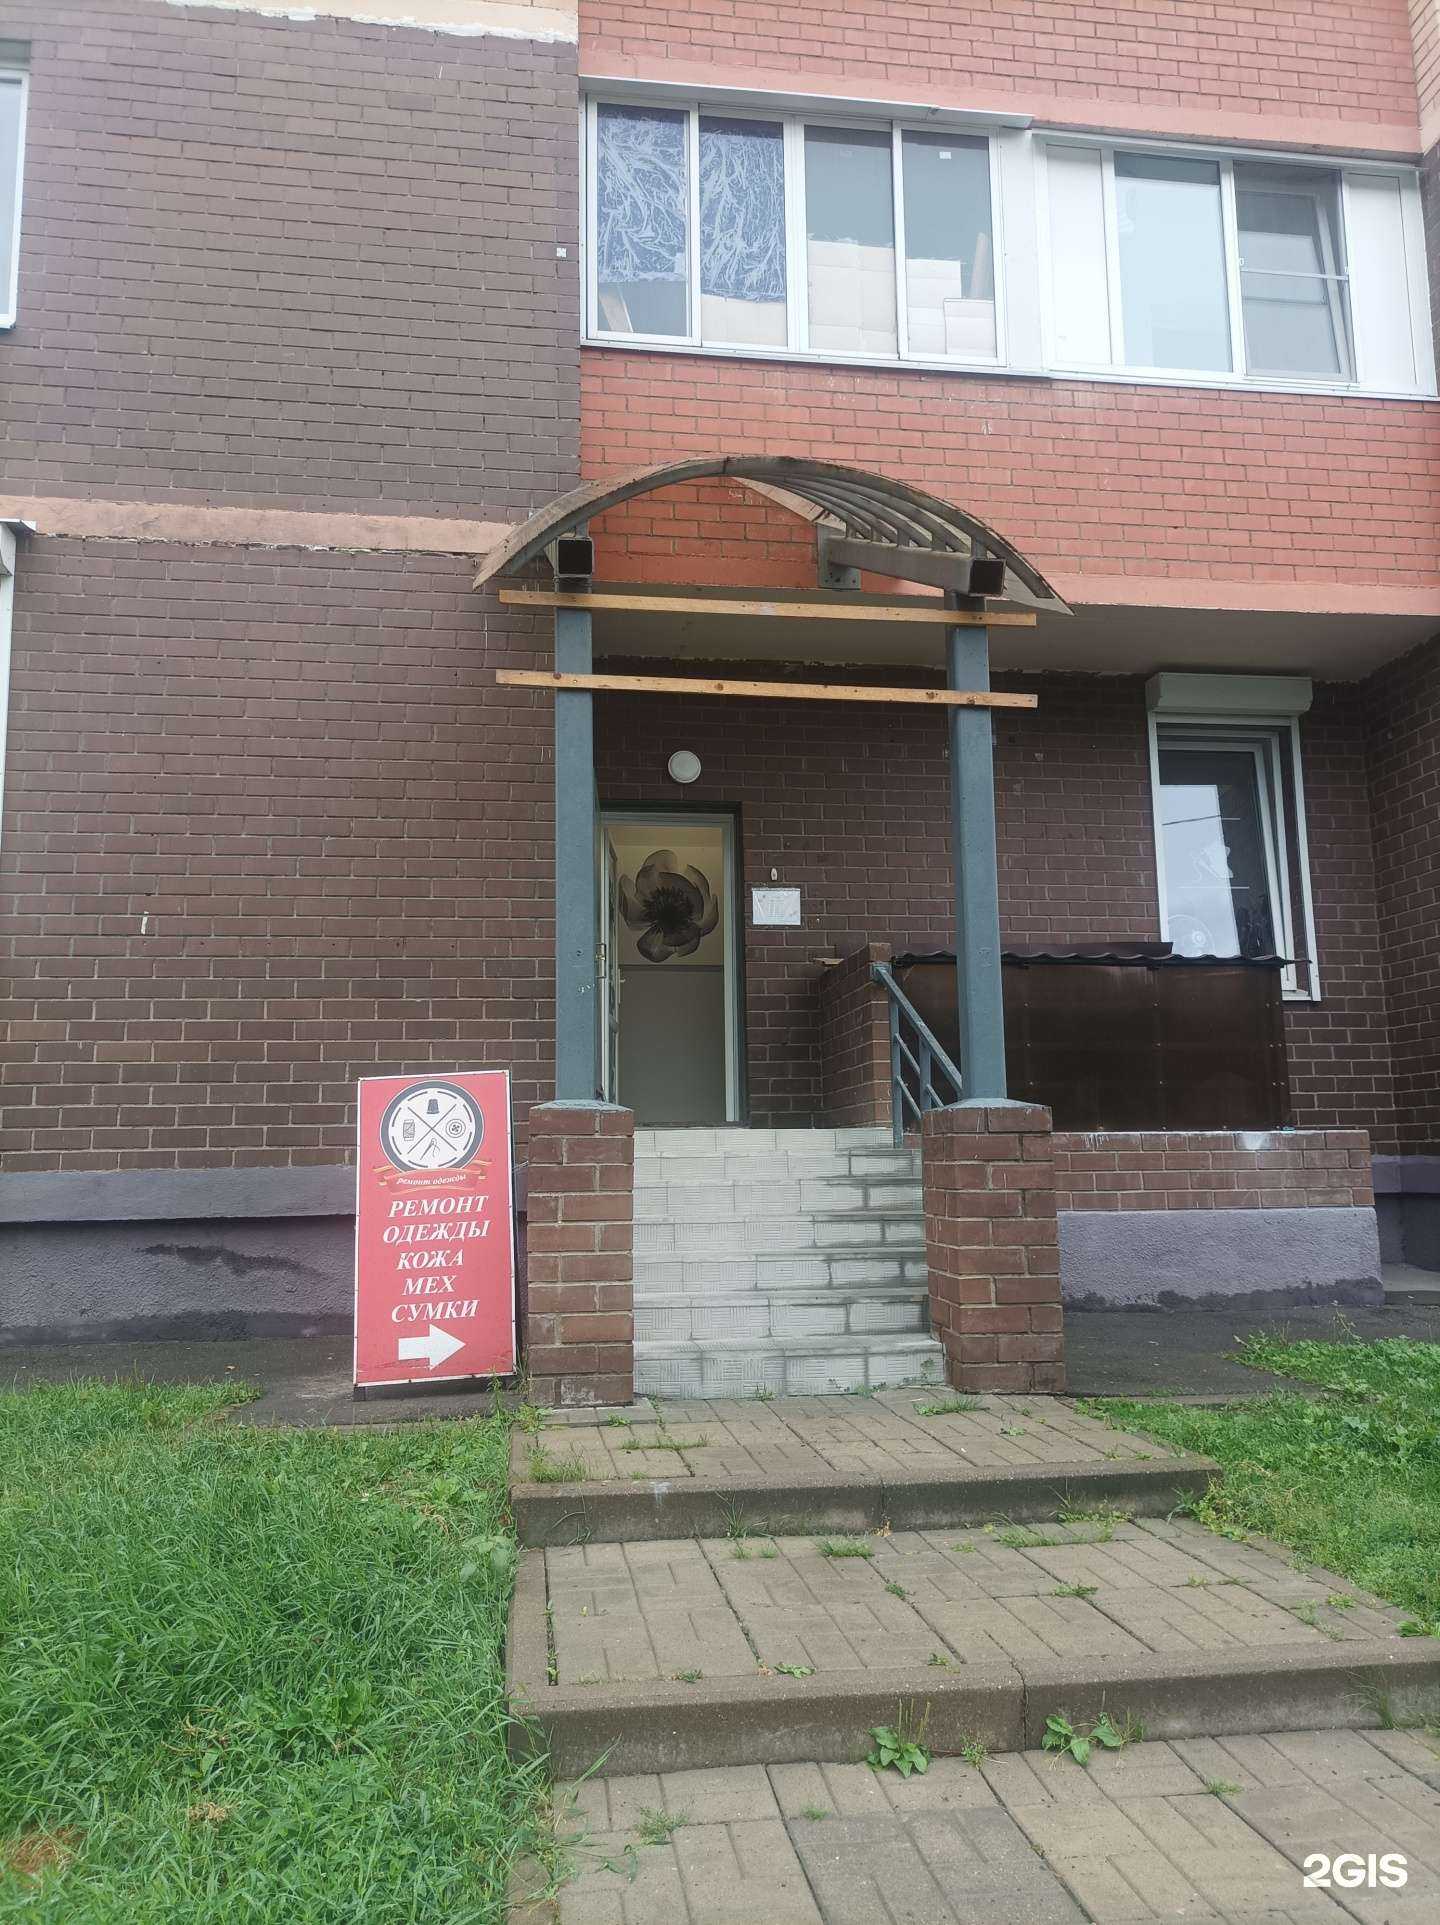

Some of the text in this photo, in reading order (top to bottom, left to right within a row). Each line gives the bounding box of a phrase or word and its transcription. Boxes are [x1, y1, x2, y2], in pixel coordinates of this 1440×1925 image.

[388, 1195, 489, 1217] РЕМОНТ
[383, 1220, 490, 1246] ОДЕЖДЫ
[396, 1249, 464, 1271] КОЖА
[402, 1275, 457, 1295] МЕХ
[391, 1299, 480, 1323] СУМКИ
